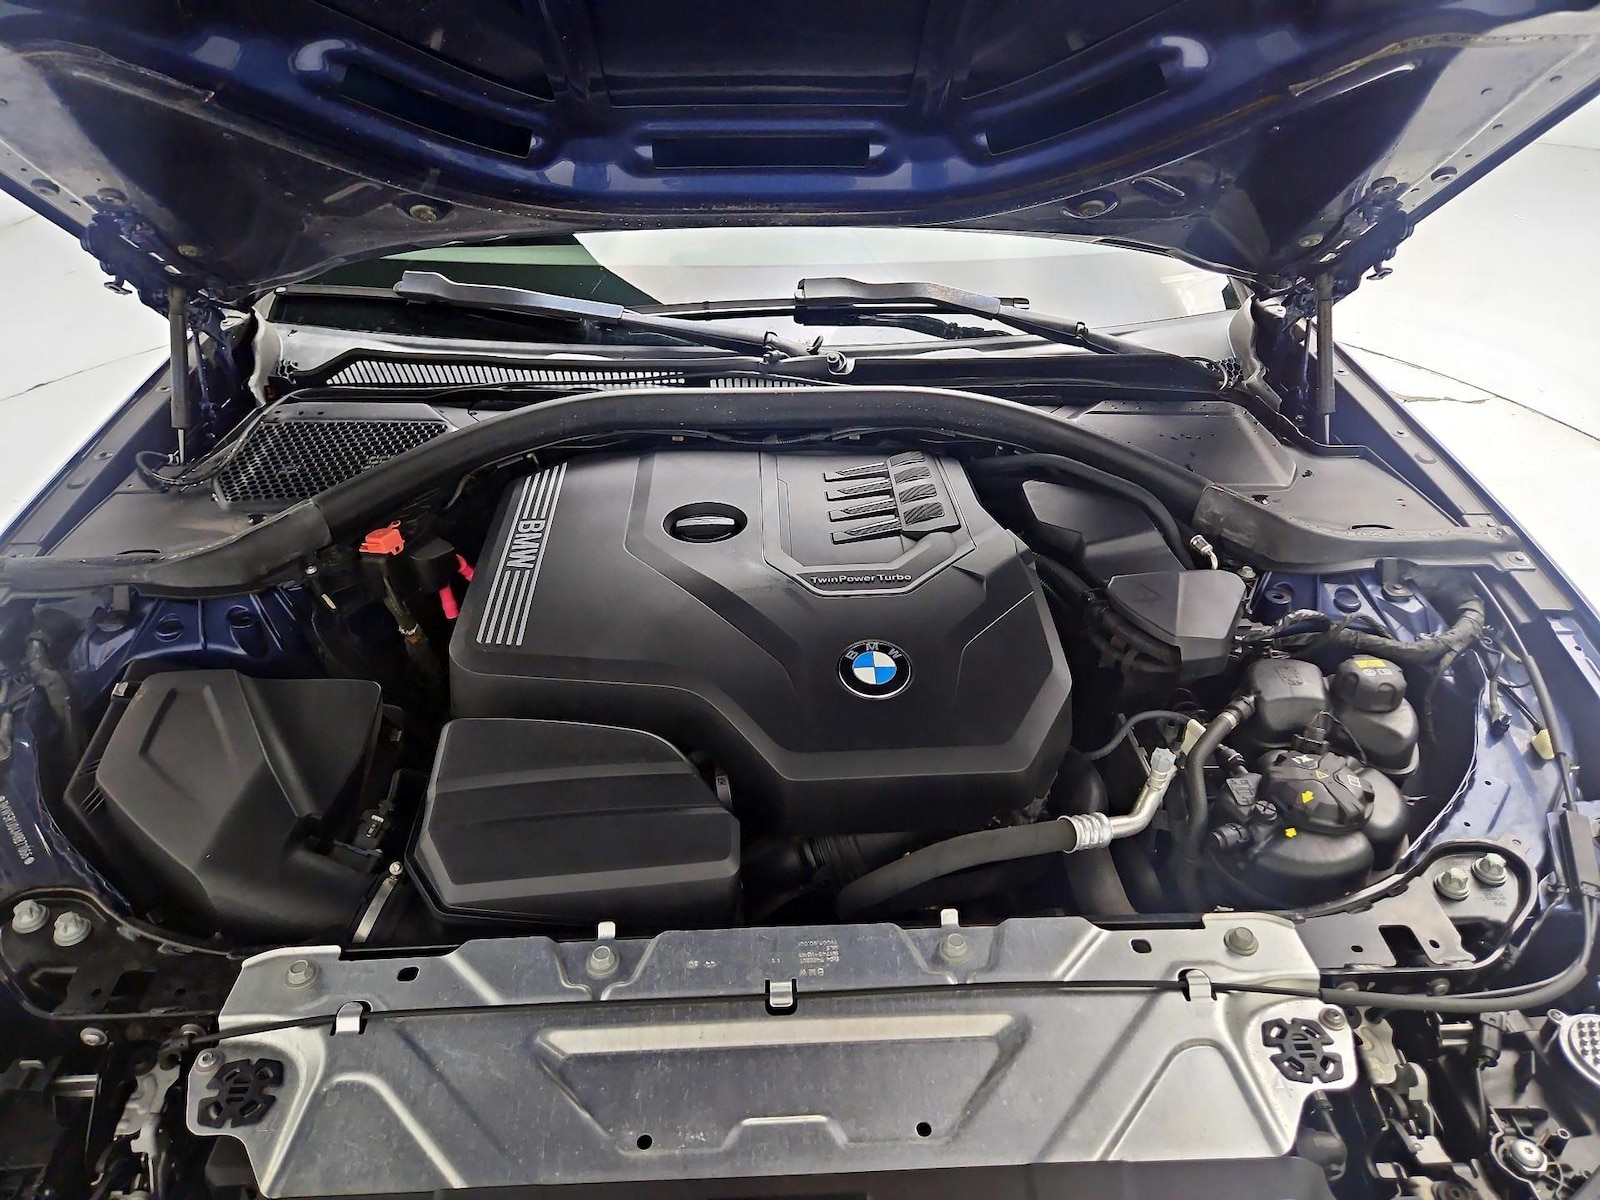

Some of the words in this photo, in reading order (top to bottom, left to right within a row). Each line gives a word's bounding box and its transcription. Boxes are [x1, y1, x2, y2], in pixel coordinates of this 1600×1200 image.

[506, 520, 546, 569] BMW
[811, 574, 876, 584] TwinPower
[877, 573, 912, 582] Turbo
[844, 642, 902, 660] BMW
